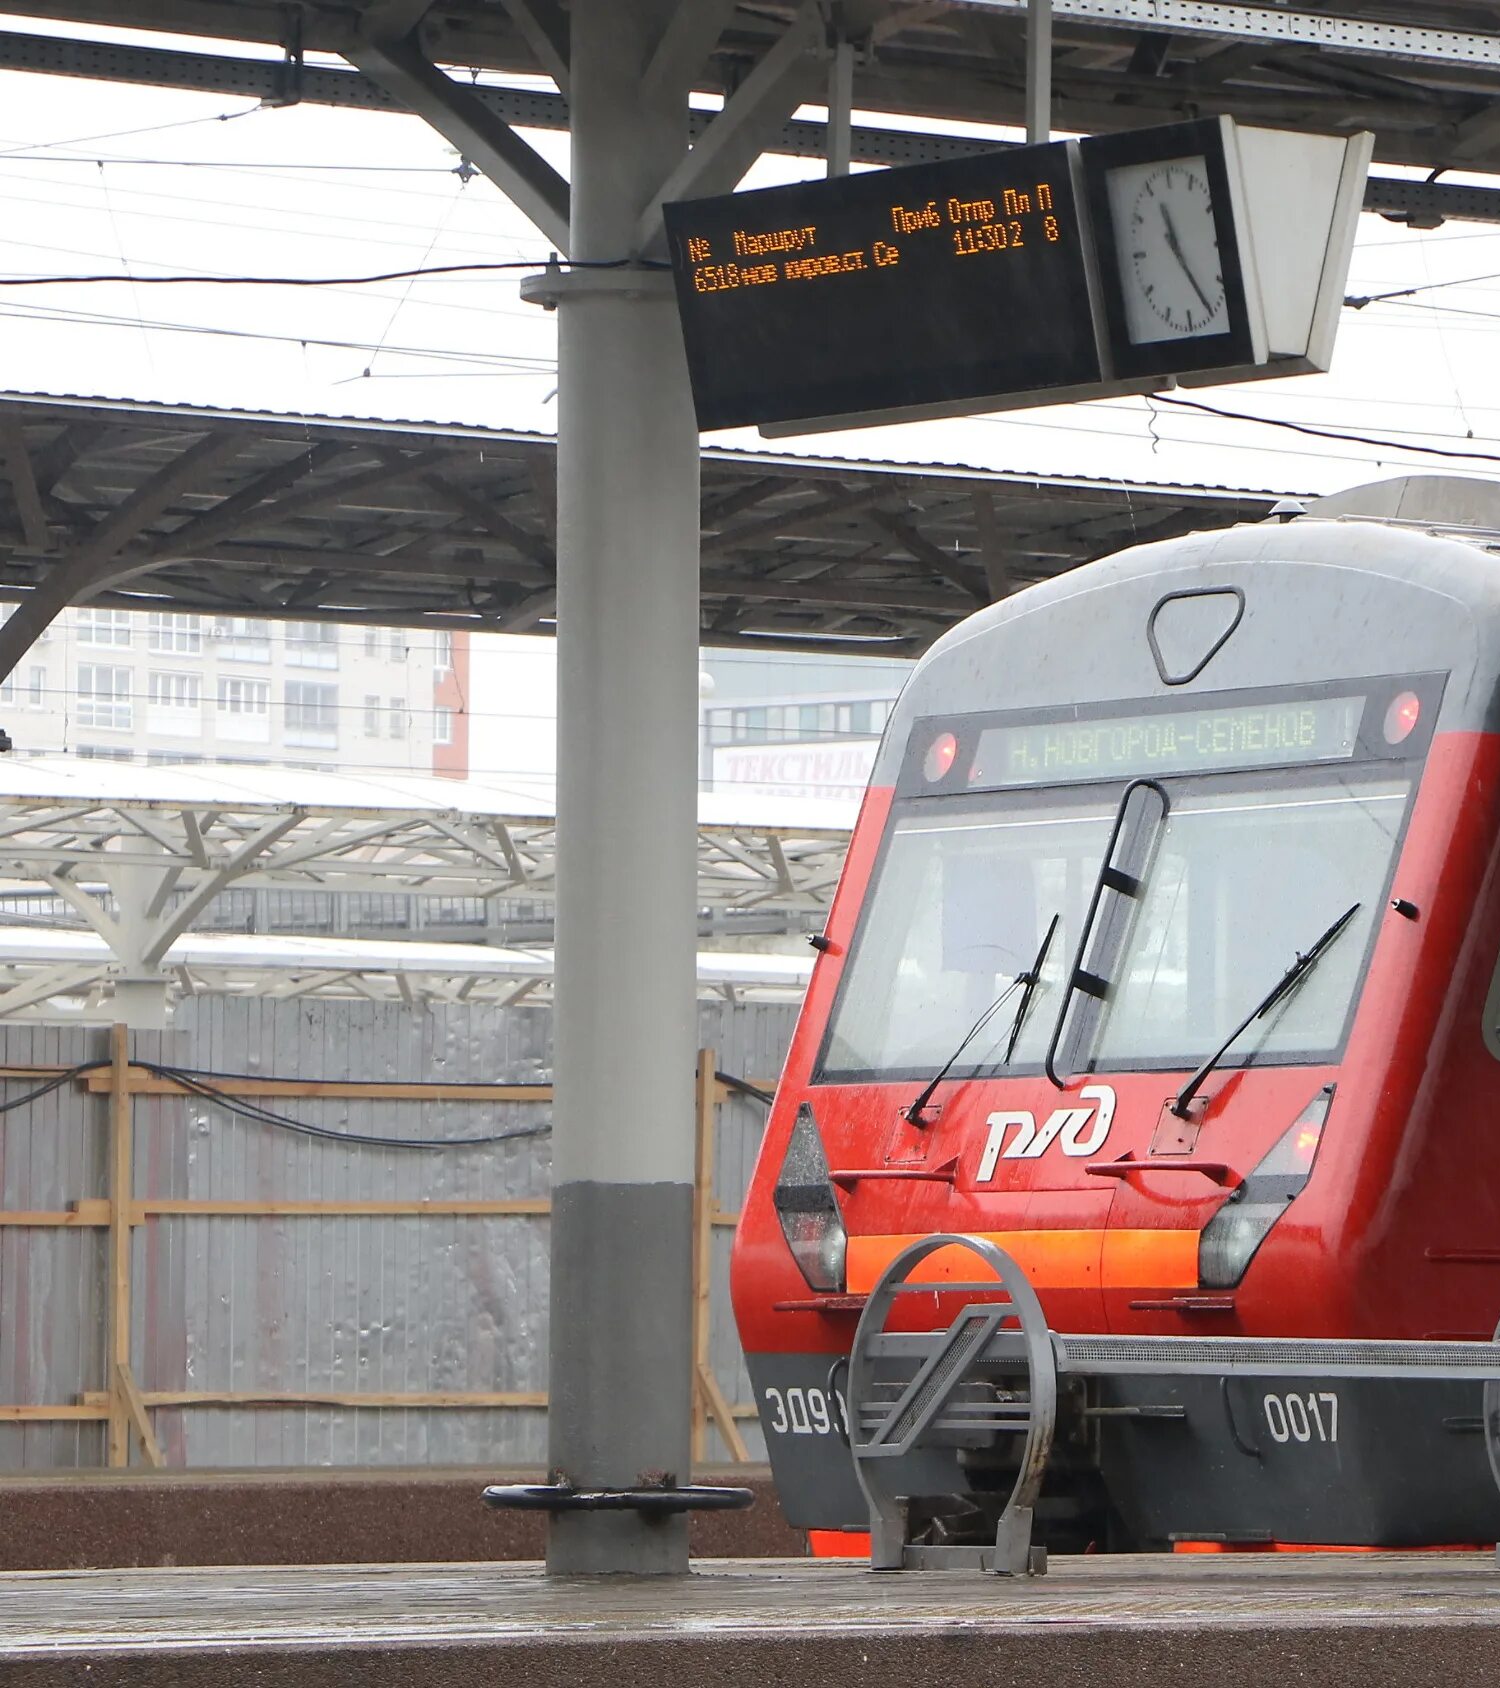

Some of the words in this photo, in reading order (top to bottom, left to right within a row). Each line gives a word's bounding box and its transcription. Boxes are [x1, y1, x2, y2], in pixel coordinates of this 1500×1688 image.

[688, 236, 712, 263] №
[733, 226, 816, 256] Маршрут
[891, 201, 941, 234] Приб
[948, 198, 995, 222] Отпр
[1003, 188, 1031, 216] Пл
[1036, 184, 1053, 210] П
[873, 241, 900, 267] Се
[1044, 215, 1059, 241] 8
[727, 751, 872, 782] ТЕКСТИЛЬ
[976, 1085, 1116, 1182] РЖД
[1263, 1392, 1338, 1443] 0017
